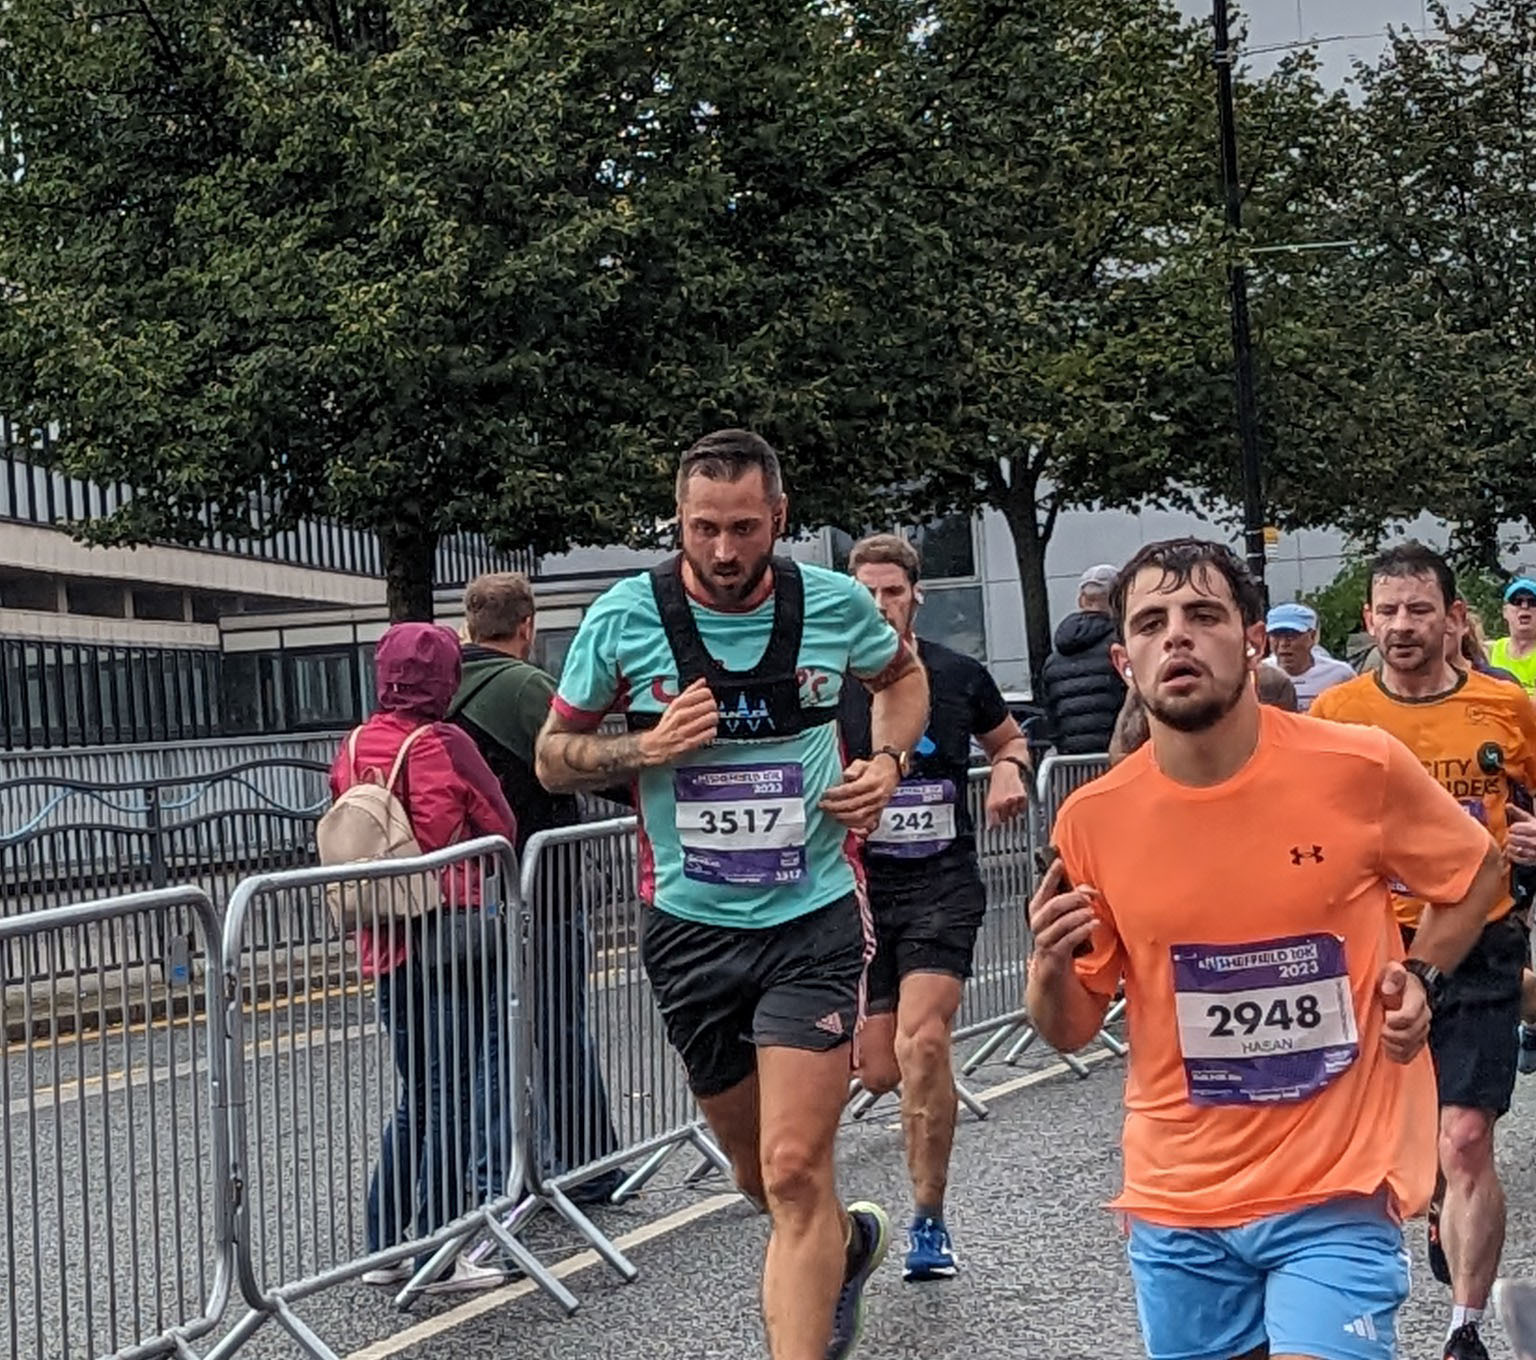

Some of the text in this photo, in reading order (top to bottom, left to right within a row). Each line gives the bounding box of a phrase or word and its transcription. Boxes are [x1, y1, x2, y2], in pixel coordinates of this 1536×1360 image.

[699, 807, 782, 834] 3517
[891, 811, 934, 831] 242
[1278, 961, 1319, 978] 2023
[1206, 994, 1321, 1037] 2948
